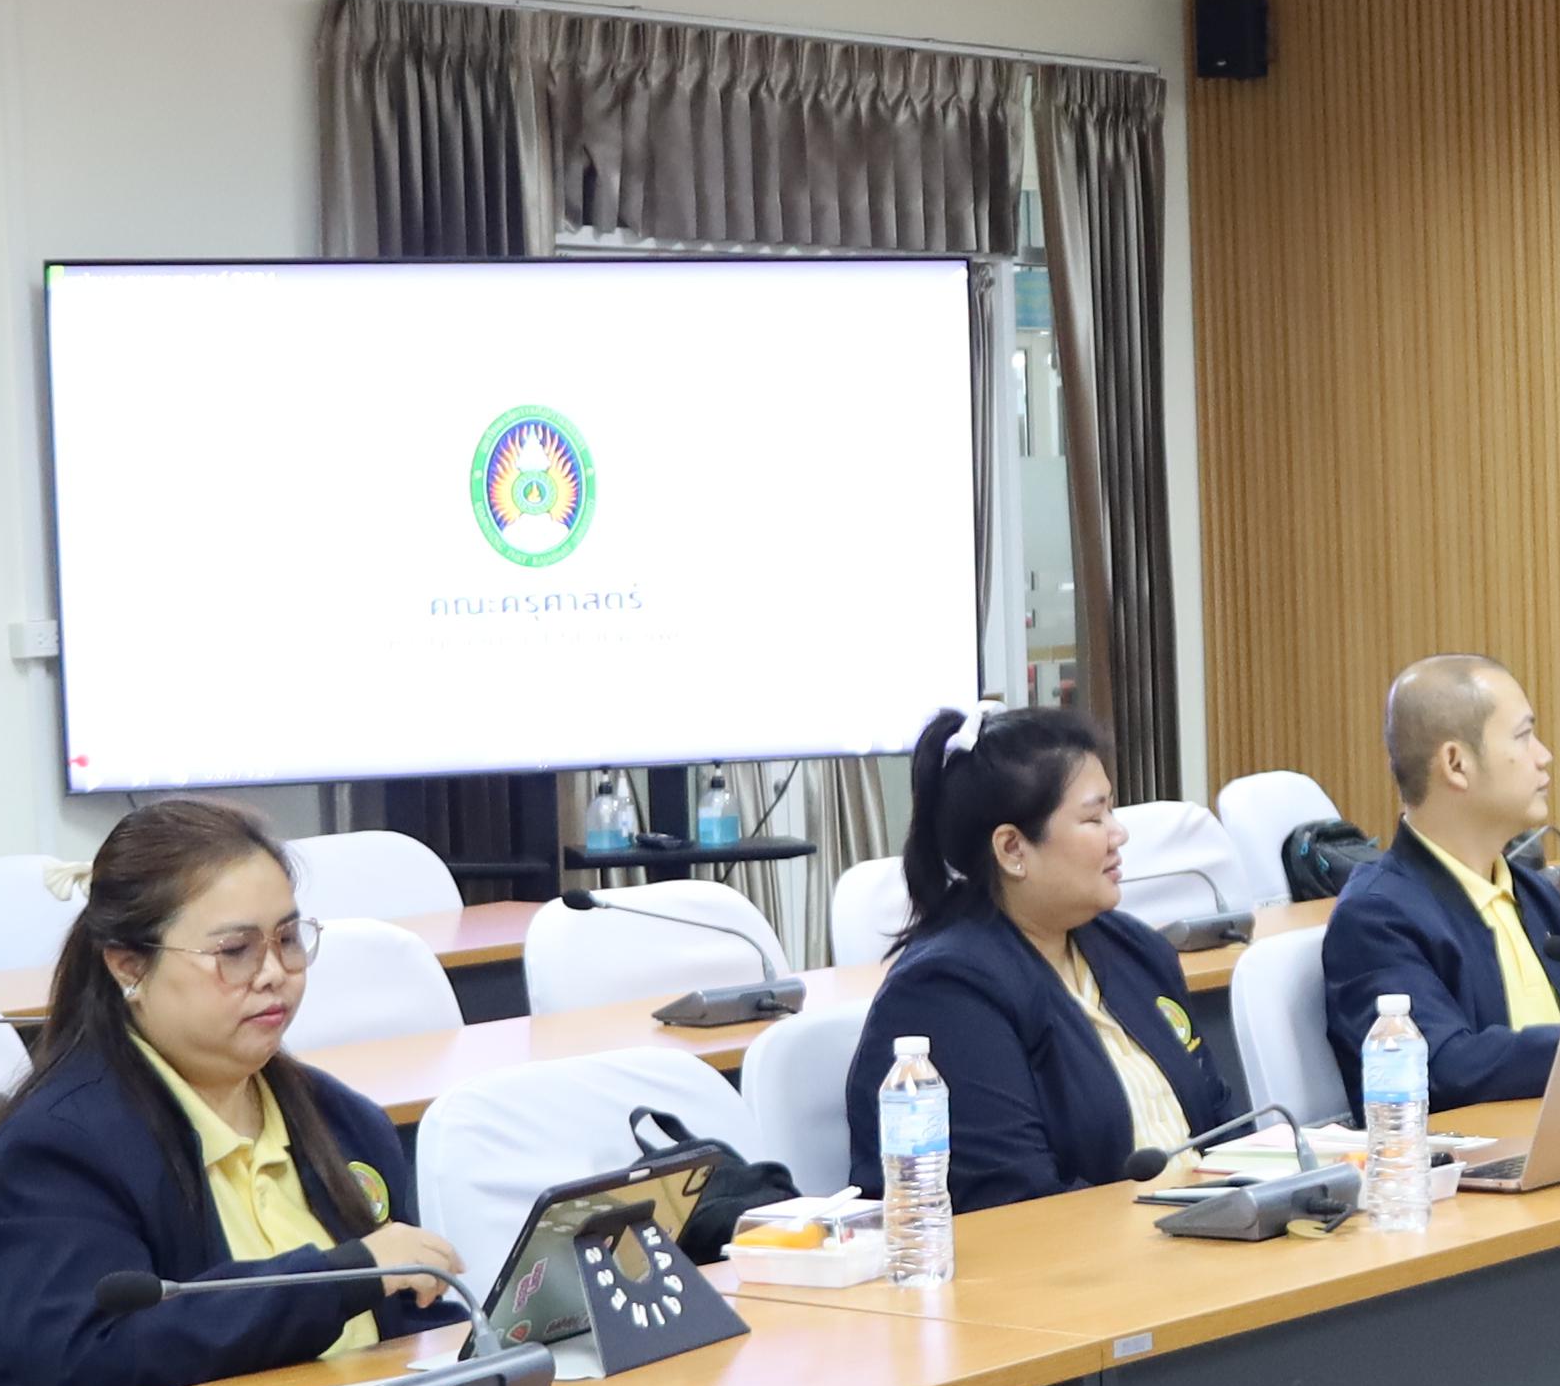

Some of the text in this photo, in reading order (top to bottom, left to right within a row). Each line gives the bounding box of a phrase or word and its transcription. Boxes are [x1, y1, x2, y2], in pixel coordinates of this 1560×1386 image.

[429, 582, 644, 621] คณะครุศาสตร์
